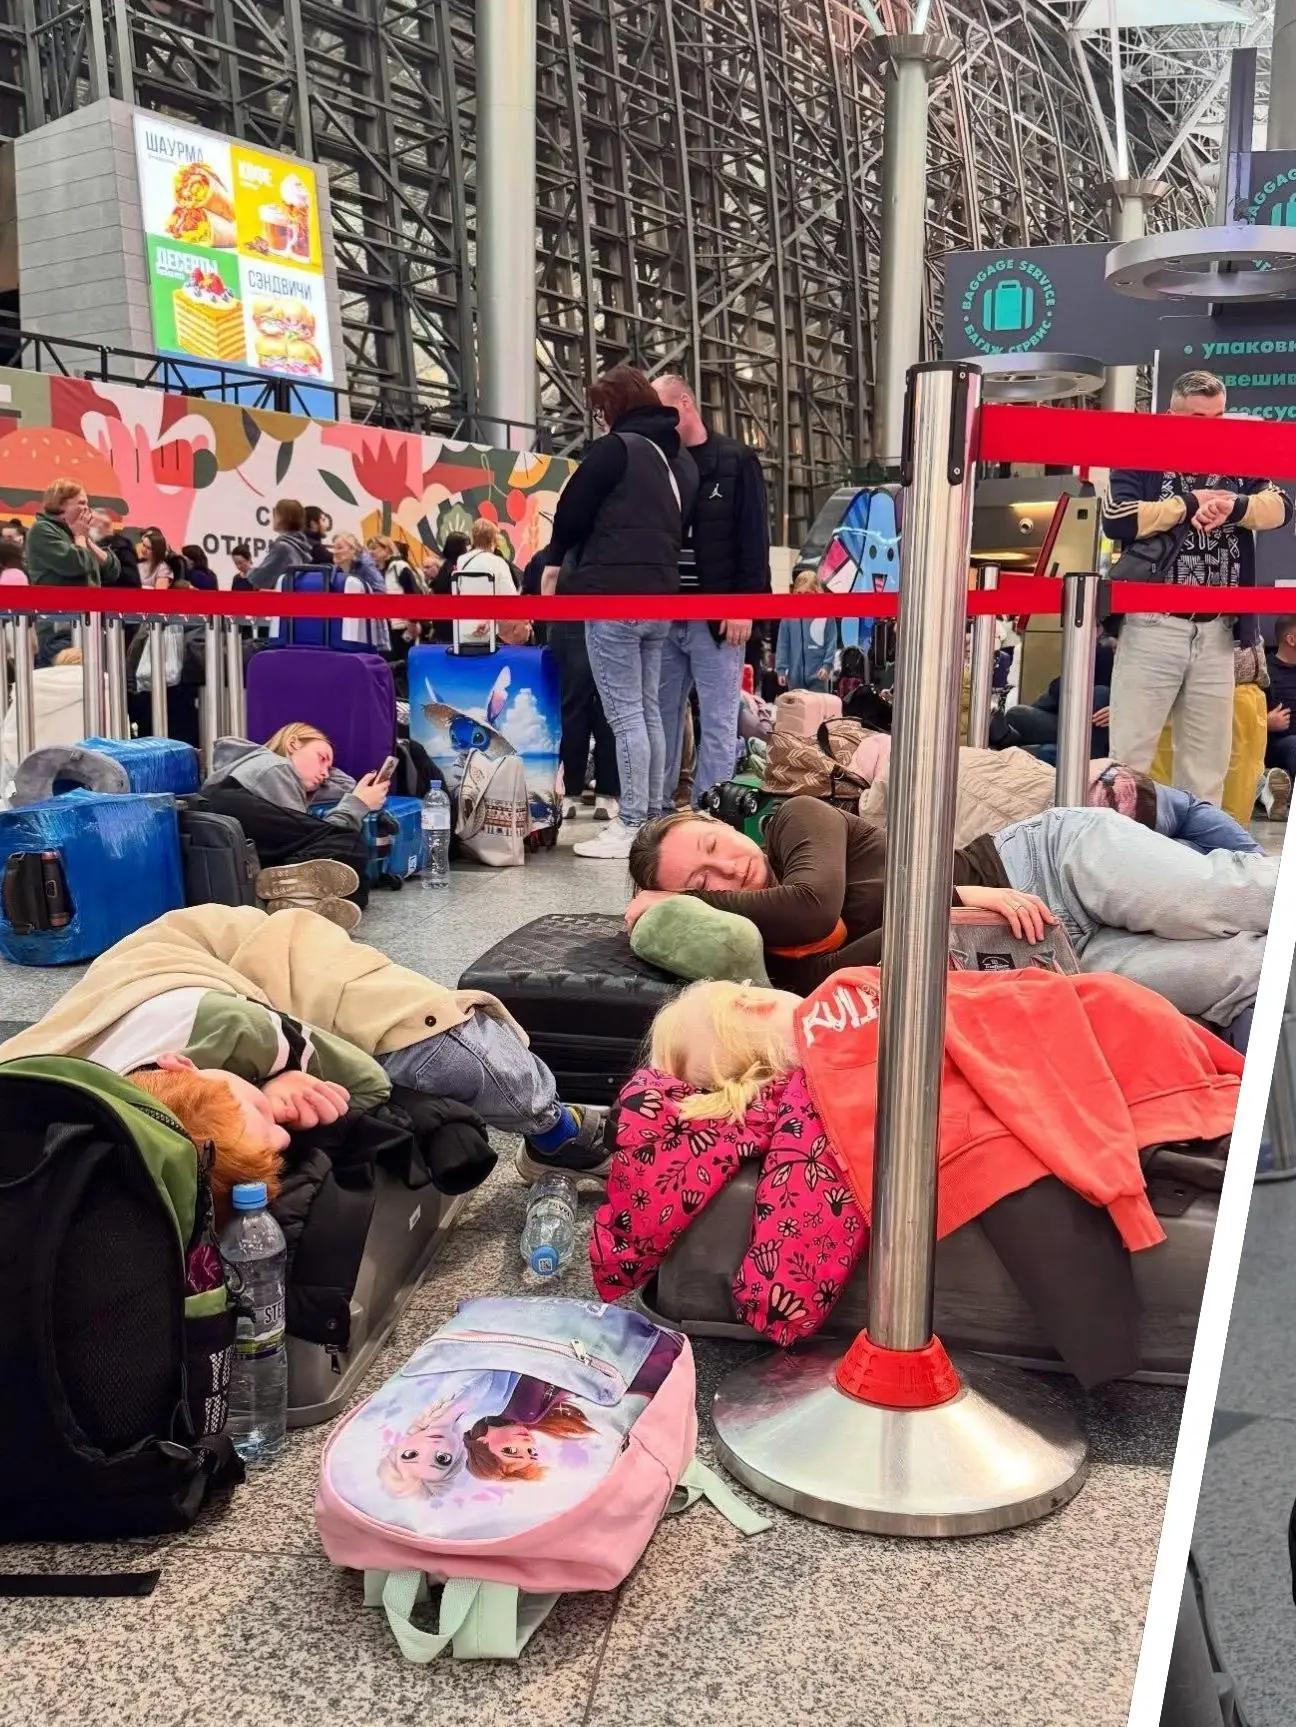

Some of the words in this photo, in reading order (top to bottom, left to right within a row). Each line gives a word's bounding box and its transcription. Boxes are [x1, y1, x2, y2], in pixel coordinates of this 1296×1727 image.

[145, 130, 204, 163] ШАУРМА
[247, 269, 312, 301] СЭНДВИЧИ
[961, 259, 1015, 310] BAGGAGE
[1018, 260, 1056, 307] SERVICE
